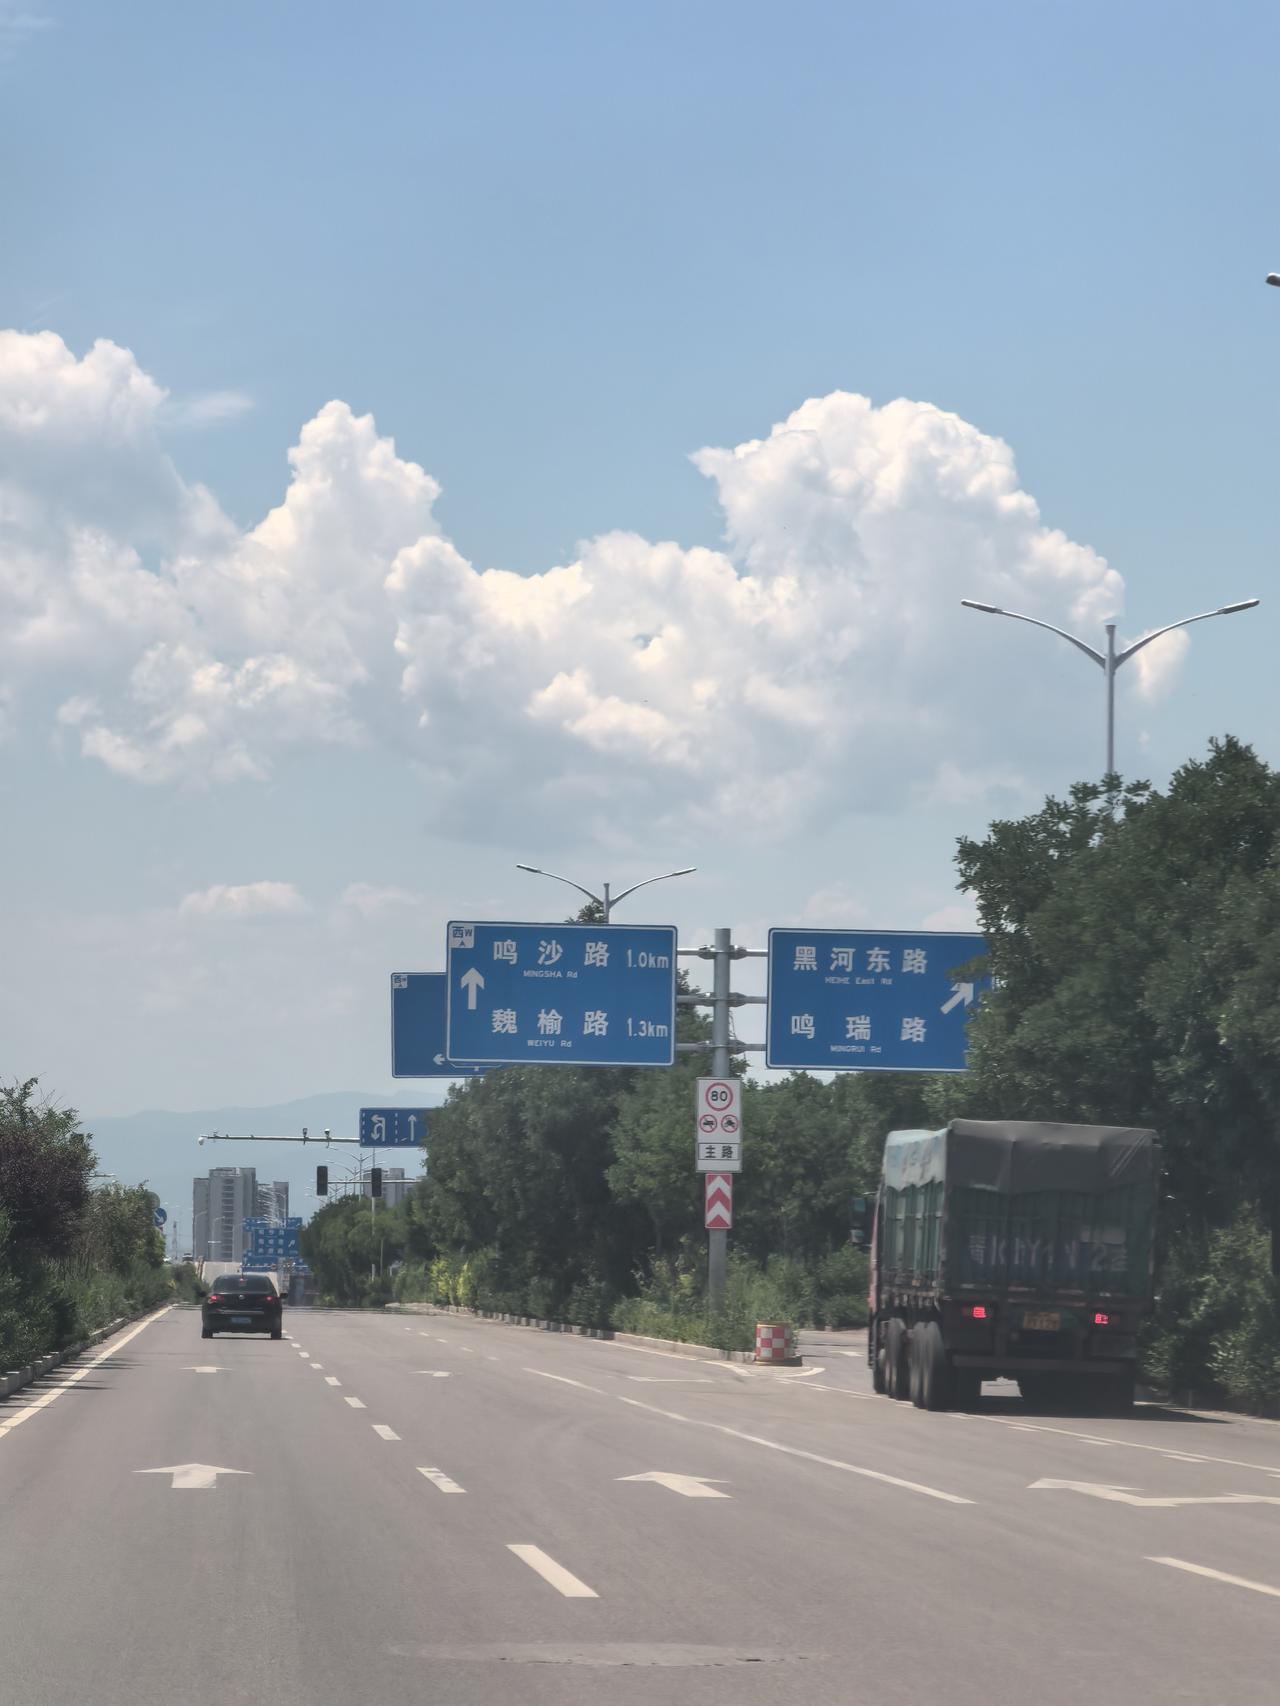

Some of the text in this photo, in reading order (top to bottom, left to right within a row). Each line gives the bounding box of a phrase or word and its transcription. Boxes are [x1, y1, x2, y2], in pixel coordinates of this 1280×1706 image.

[493, 939, 669, 968] 鸣沙路 1.0km
[793, 946, 928, 974] 黑河东路
[566, 970, 578, 979] Rd
[491, 1008, 668, 1037] 魏榆路 1.3km
[791, 1013, 928, 1043] 鸣瑞路
[560, 1040, 572, 1048] Rd
[711, 1090, 728, 1102] 80
[704, 1145, 734, 1159] 主路
